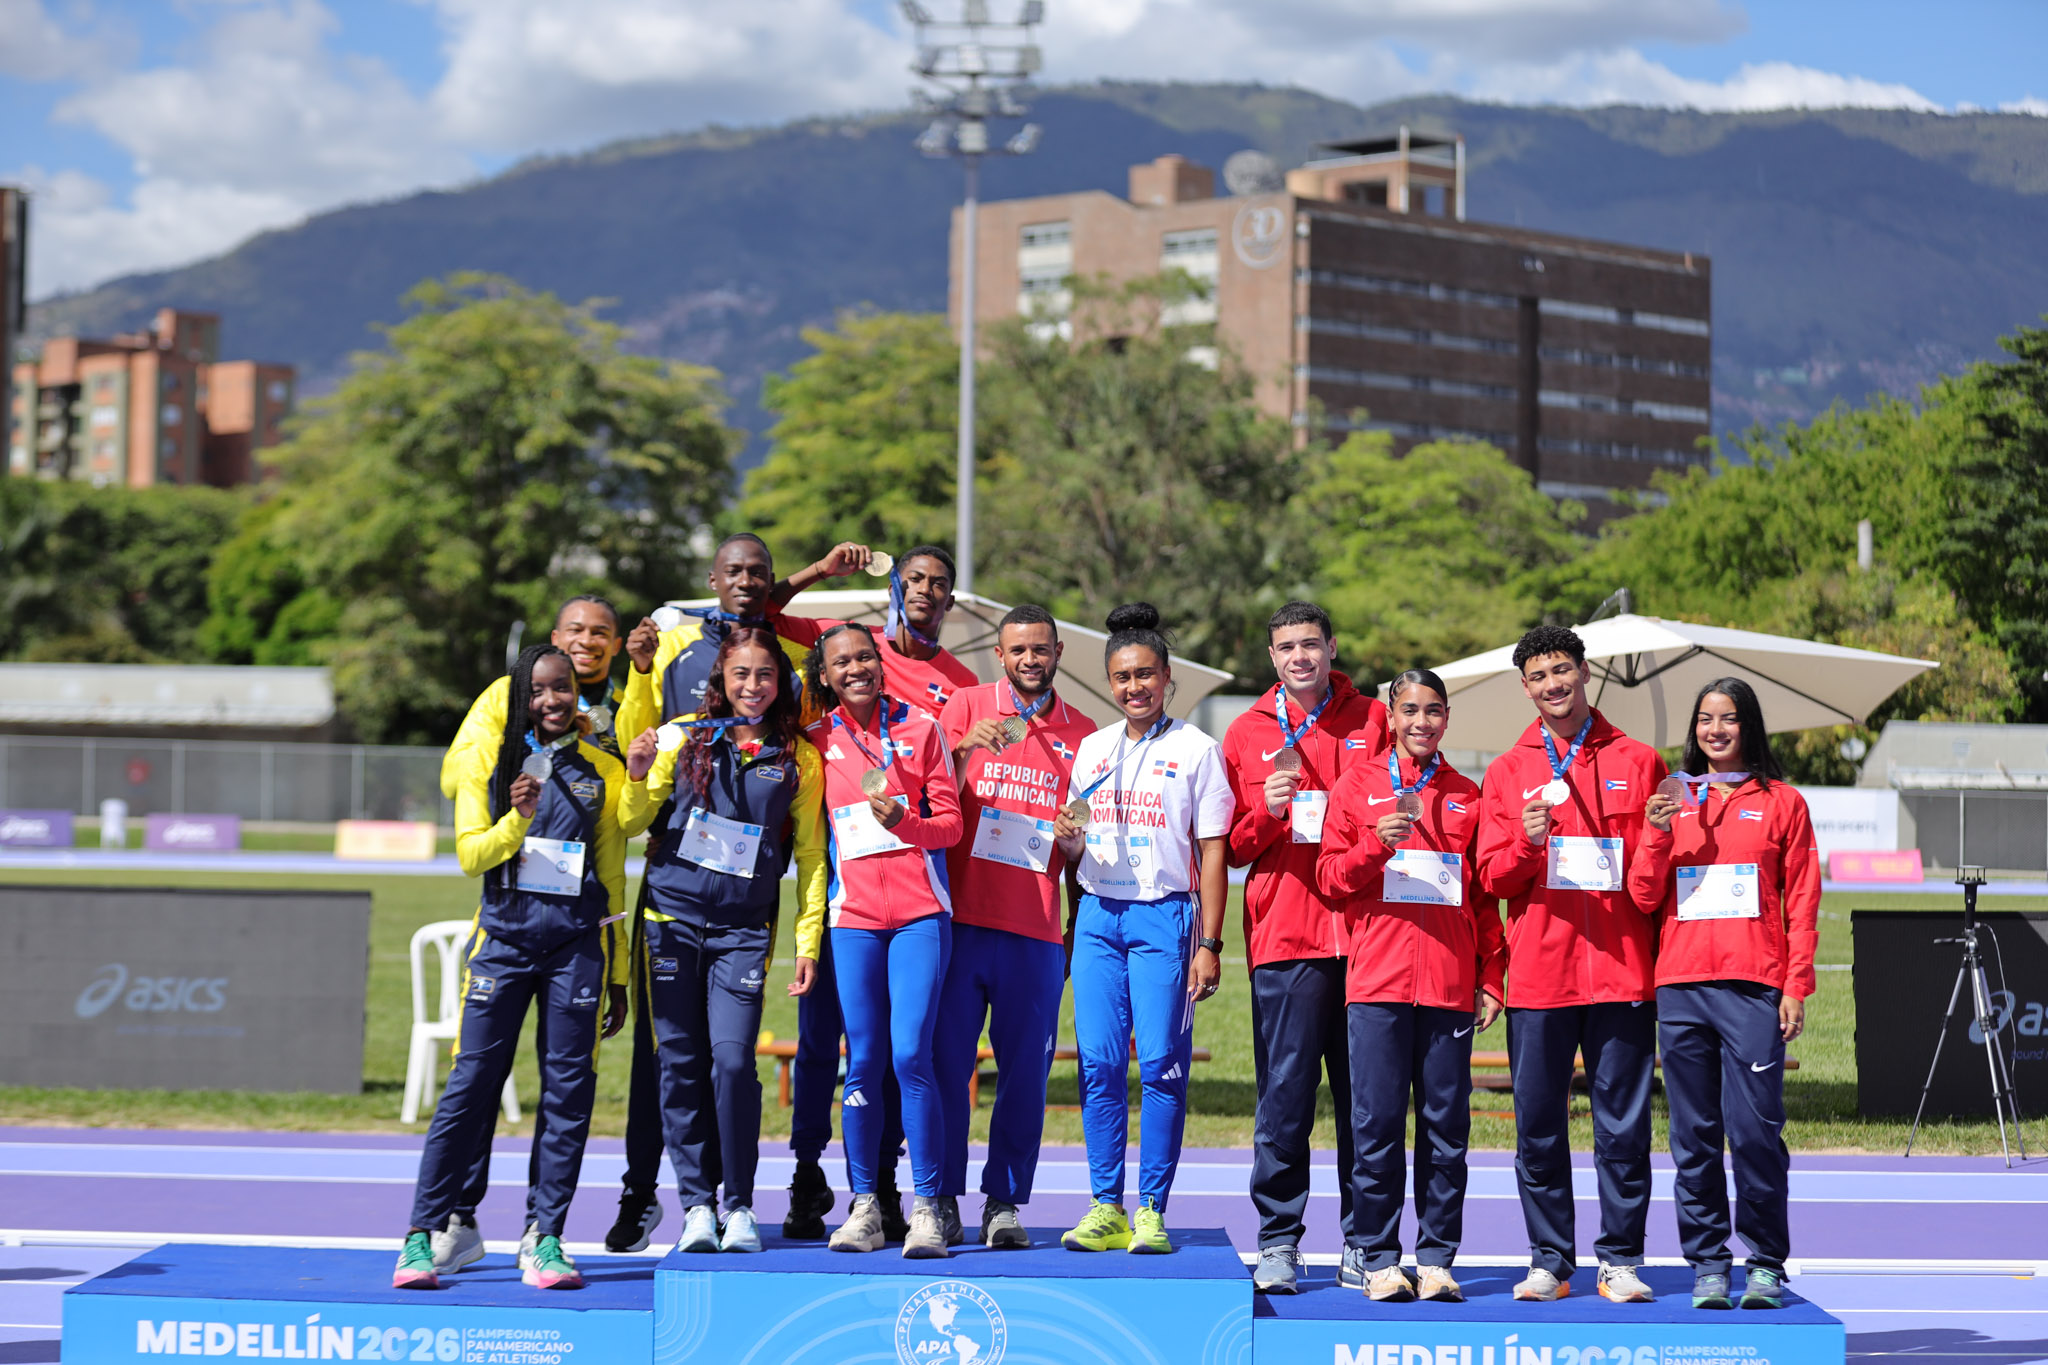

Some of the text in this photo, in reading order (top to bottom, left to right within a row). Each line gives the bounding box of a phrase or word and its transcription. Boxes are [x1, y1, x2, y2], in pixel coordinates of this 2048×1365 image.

[983, 761, 1060, 791] REPUBLICA
[1092, 789, 1162, 810] REPUBLICA
[125, 976, 229, 1012] asics
[898, 1283, 1004, 1335] PANAM ATHLETICS
[467, 1328, 561, 1340] CAMPEONATO
[466, 1340, 574, 1353] PANAMERICANO
[914, 1340, 951, 1354] APA
[1664, 1346, 1757, 1357] CAMPEONATO
[466, 1352, 562, 1365] DE ATLETISMO
